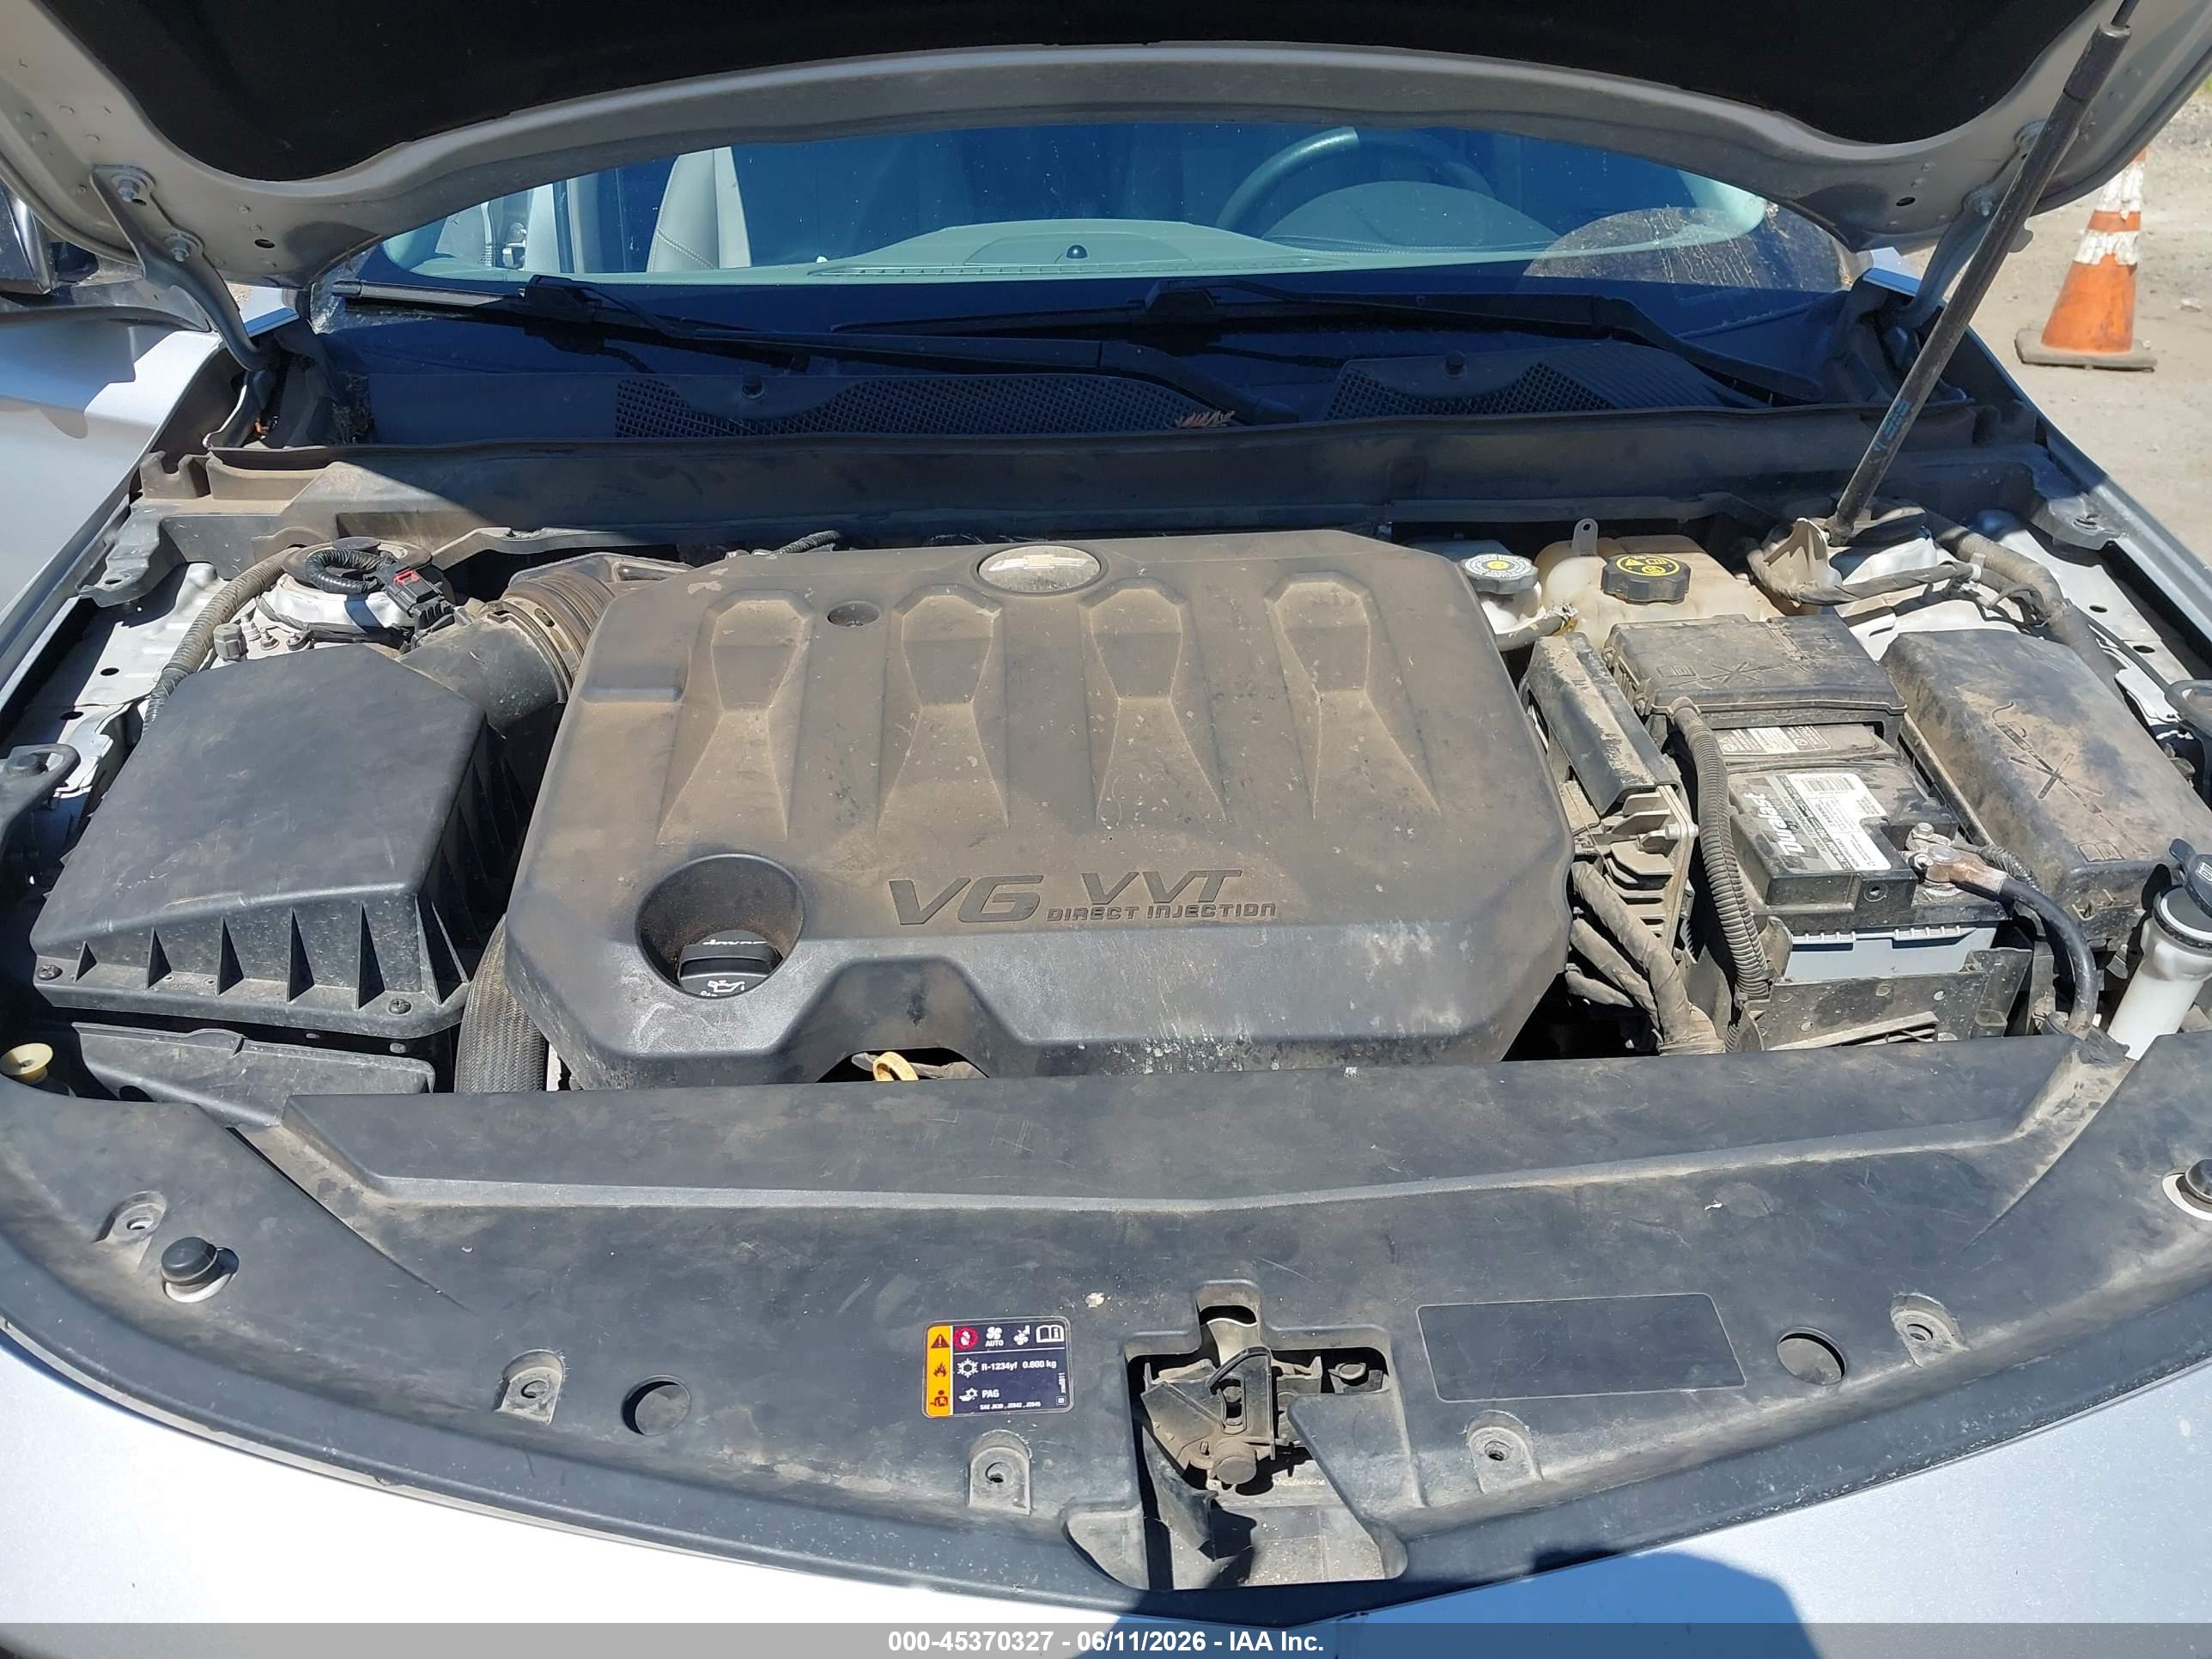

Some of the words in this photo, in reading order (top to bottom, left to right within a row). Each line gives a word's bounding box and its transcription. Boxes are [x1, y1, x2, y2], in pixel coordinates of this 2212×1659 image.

[1745, 792, 1806, 856] Duralast
[888, 874, 1044, 926] V6
[1081, 869, 1243, 906] VVT
[1046, 905, 1139, 923] DIRECT
[1146, 902, 1277, 920] INJECTION
[1046, 1359, 1057, 1369] kg
[981, 1389, 1000, 1399] PAG
